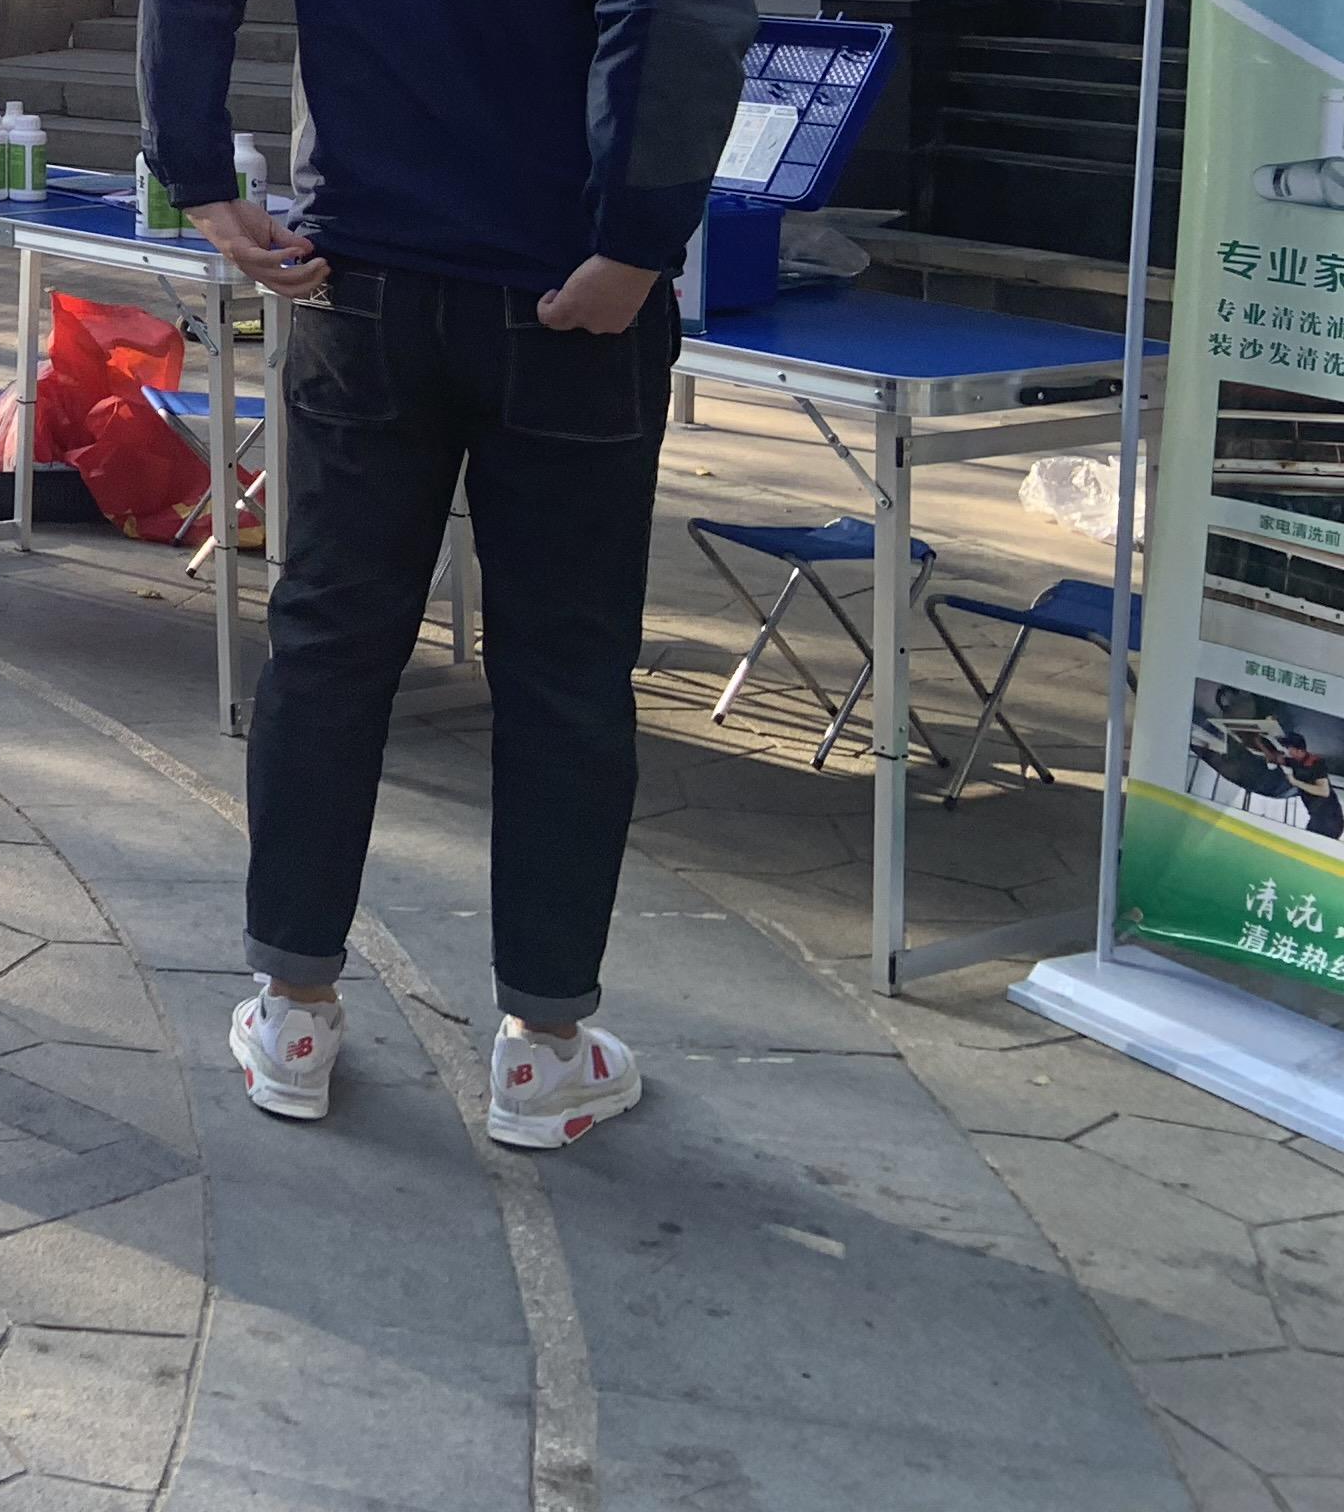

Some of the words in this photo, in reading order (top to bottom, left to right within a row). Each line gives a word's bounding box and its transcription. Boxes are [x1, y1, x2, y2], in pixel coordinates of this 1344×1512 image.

[1208, 333, 1344, 376] 装沙发清洗
[1260, 514, 1341, 547] 家电清洗前
[1245, 660, 1328, 696] 家电清洗后
[1246, 876, 1344, 939] 清洗
